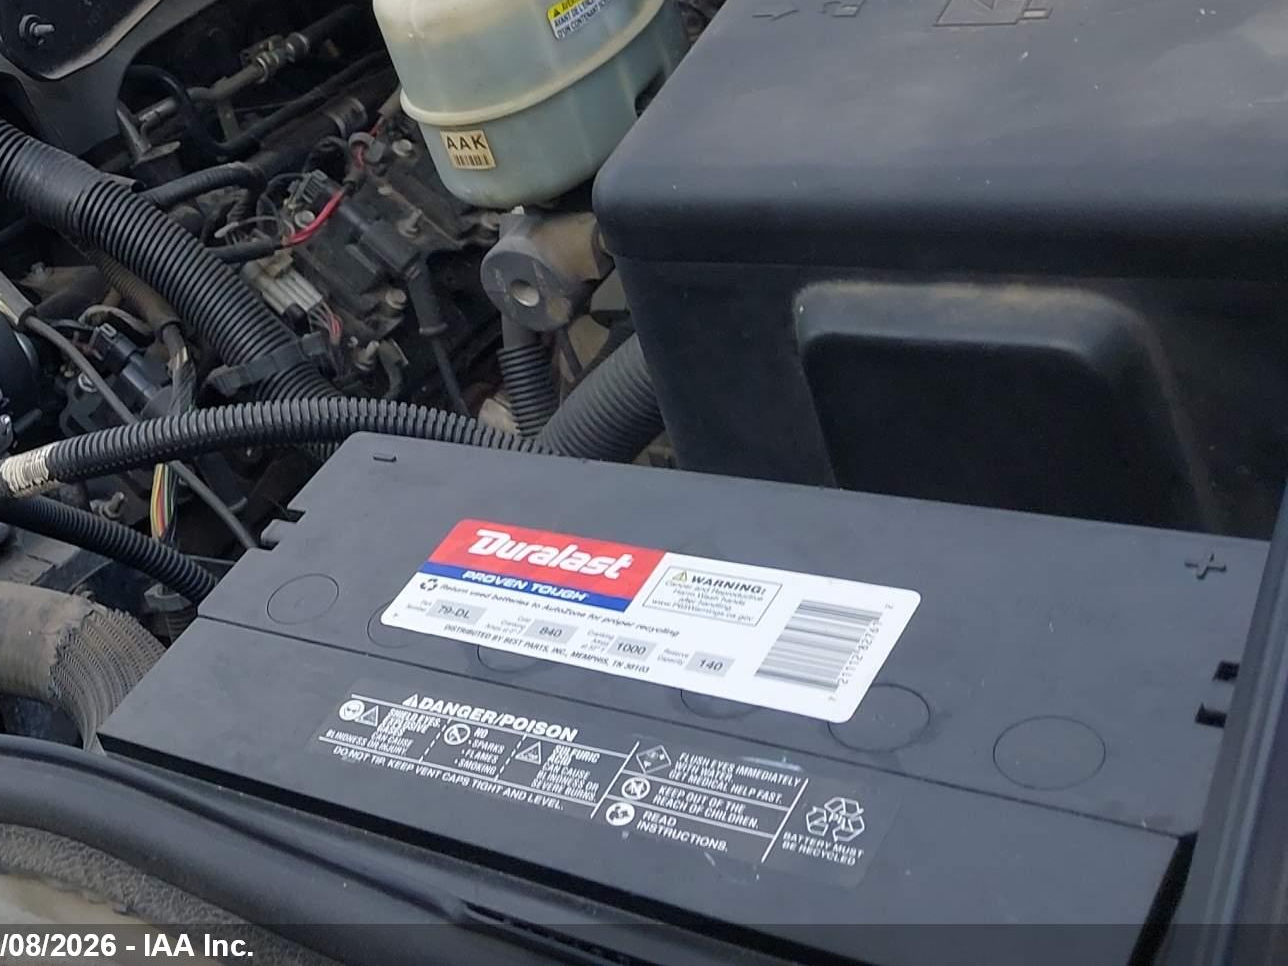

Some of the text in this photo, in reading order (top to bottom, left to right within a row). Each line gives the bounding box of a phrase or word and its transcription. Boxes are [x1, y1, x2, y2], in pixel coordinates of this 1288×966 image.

[446, 134, 488, 150] AAK
[468, 528, 634, 579] Duralast
[462, 569, 587, 602] PROVEN TOUGH
[438, 604, 471, 619] 79-DL
[439, 584, 469, 595] Return
[470, 590, 493, 599] used
[492, 594, 530, 606] batteries
[542, 604, 586, 618] AutoZone
[586, 614, 601, 624] for
[600, 617, 636, 629] proper
[635, 622, 680, 637] recycling
[539, 626, 563, 638] 840
[443, 623, 492, 640] DISTRIBUTED
[492, 634, 503, 643] BY
[503, 636, 524, 648] BEST
[612, 659, 624, 668] TN
[617, 642, 647, 656] 1000
[699, 658, 724, 672] 140
[415, 696, 579, 743] DANGER/POISON
[326, 729, 368, 747] BLINDNESS
[367, 739, 380, 750] OR
[370, 731, 414, 748] CAN CAUSE
[473, 727, 489, 739] NO
[472, 738, 505, 754] SPARKS
[553, 744, 601, 763] SULFURIC
[465, 749, 499, 764] FLAMES
[547, 753, 572, 766] ACID
[458, 758, 497, 775] SMOKING
[542, 762, 591, 779] CAN CAUSE
[674, 761, 700, 775] WITH
[679, 752, 802, 788] FLUSH EYES IMMEDIATELY
[333, 745, 349, 756] DO
[349, 749, 369, 762] NOT
[387, 759, 415, 772] KEEP
[415, 766, 442, 779] VENT
[442, 773, 471, 787] CAPS
[471, 780, 503, 794] TIGHT
[502, 787, 527, 801] AND
[526, 793, 564, 811] LEVEL.
[531, 778, 564, 794] SEVERE
[536, 770, 599, 791] BLINDNESS OR
[669, 769, 688, 781] GET
[687, 774, 730, 793] MEDICAL
[730, 784, 757, 798] HELP
[652, 794, 689, 811] REACH
[688, 803, 704, 814] OF
[658, 785, 746, 813] KEEP OUT OF THE
[642, 810, 677, 827] READ
[781, 840, 856, 866] BE RECYCLED
[782, 831, 864, 859] BATTERY MUST
